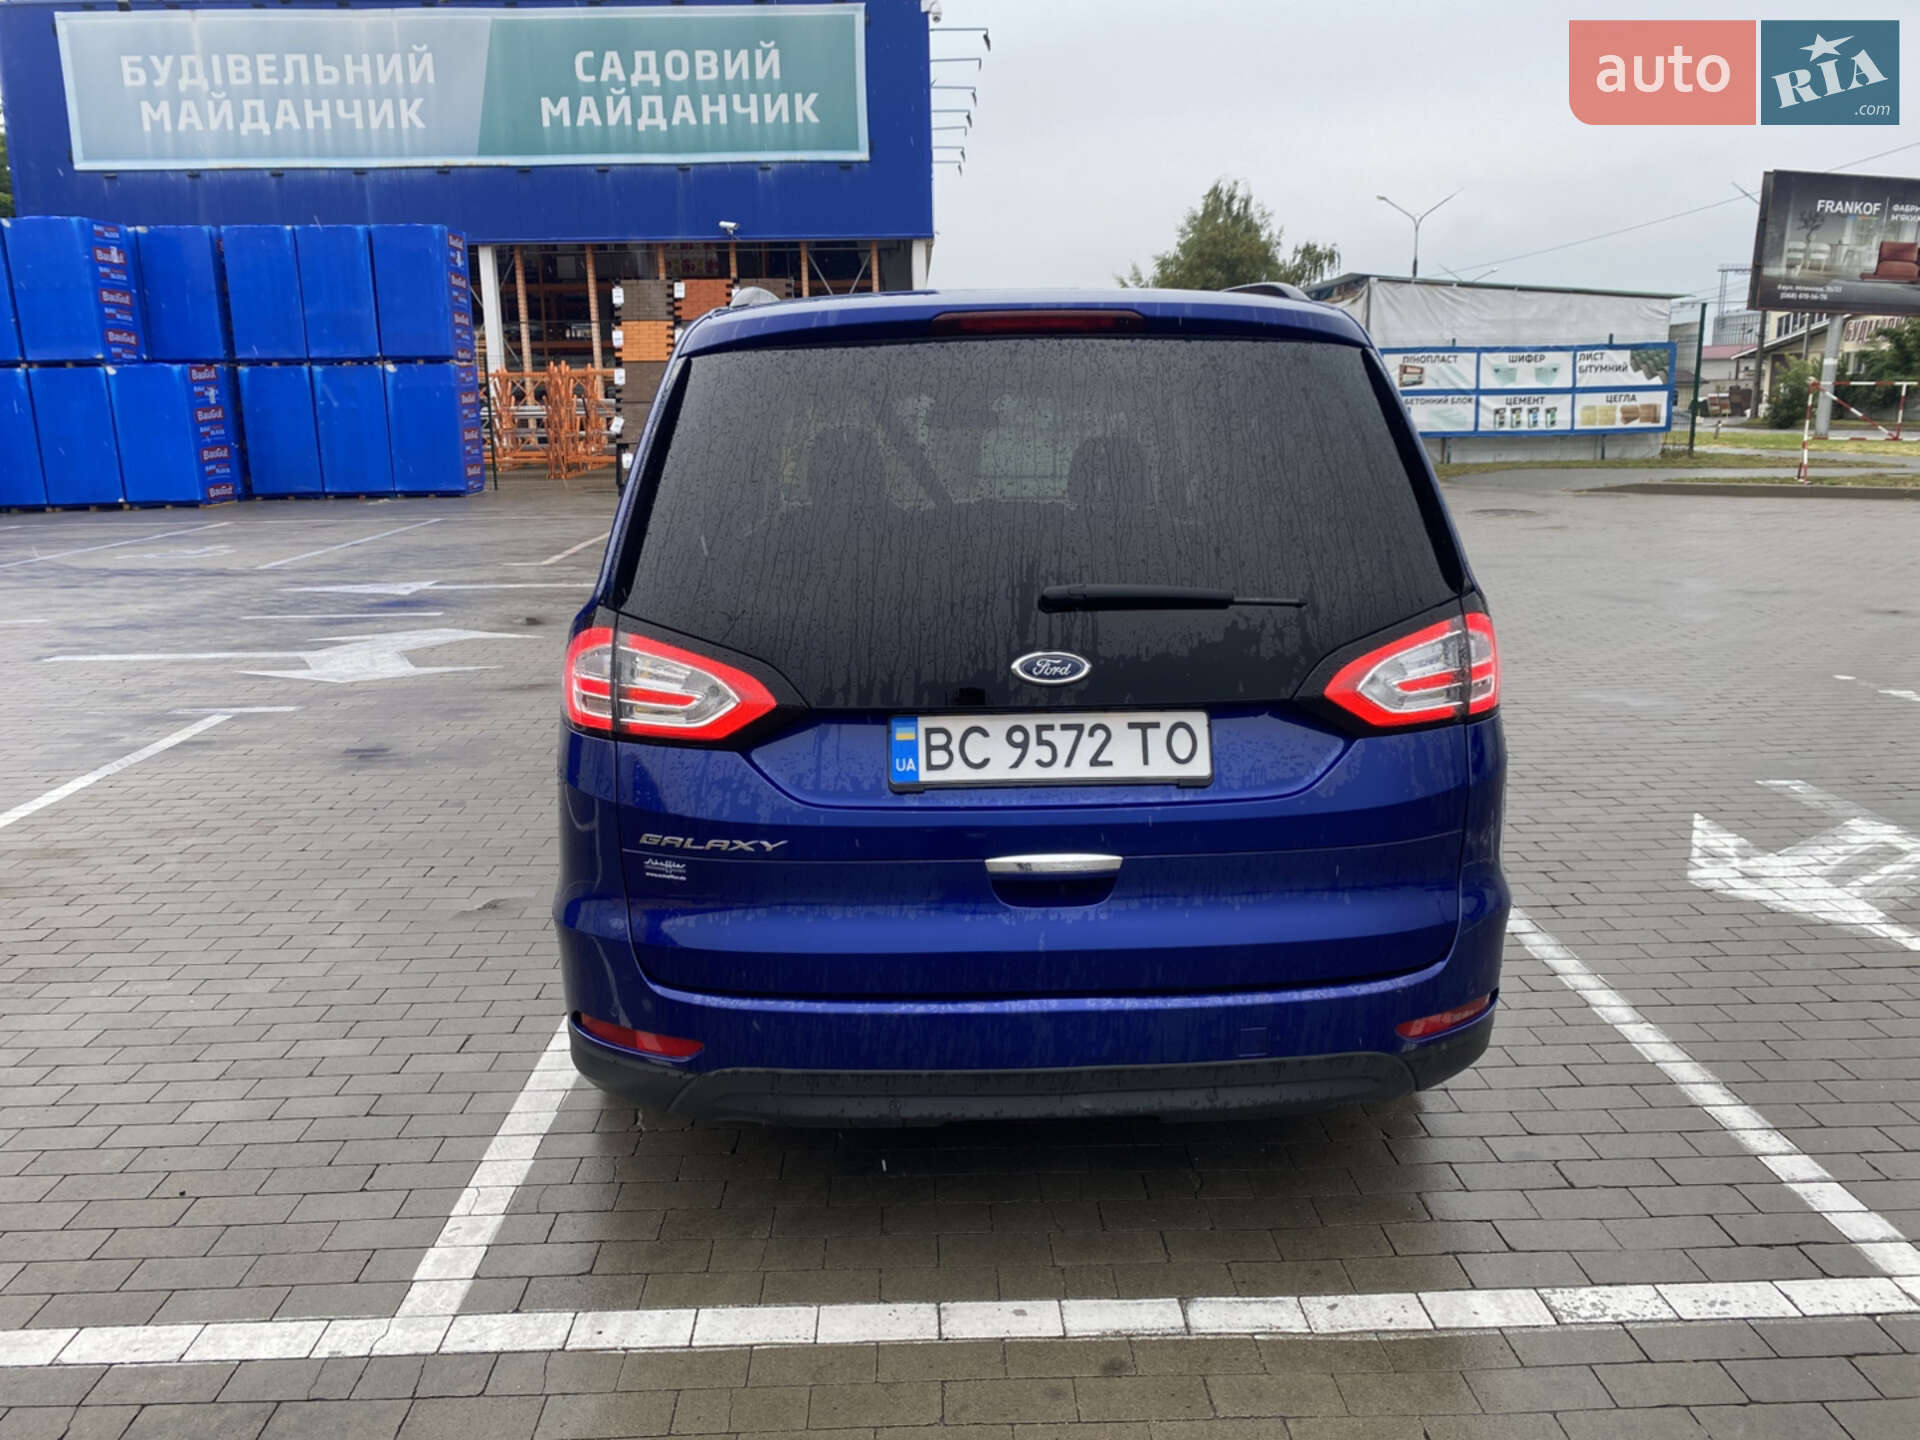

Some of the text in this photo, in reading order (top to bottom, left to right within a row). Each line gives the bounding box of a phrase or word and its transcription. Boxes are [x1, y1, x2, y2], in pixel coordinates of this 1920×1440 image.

[120, 44, 437, 93] БУДІВЕЛЬНИЙ
[573, 40, 782, 87] САДОВИЙ
[139, 93, 427, 137] МАЙДАНЧИК
[539, 90, 821, 133] МАЙДАНЧИК
[1816, 199, 1881, 215] FRANKOF
[1402, 354, 1458, 364] ПІНОПЛАСТ
[1508, 354, 1546, 364] ШИФЕР
[1578, 352, 1605, 361] ЛИСТ
[1578, 362, 1629, 374] БІТУМНИЙ
[1505, 396, 1545, 406] ЦЕМЕНТ
[1605, 394, 1638, 403] ЦЕГЛА
[1032, 658, 1072, 677] Ford
[924, 721, 1198, 771] BC 9572 TO
[895, 757, 917, 772] UA
[639, 833, 789, 852] GALAXY
